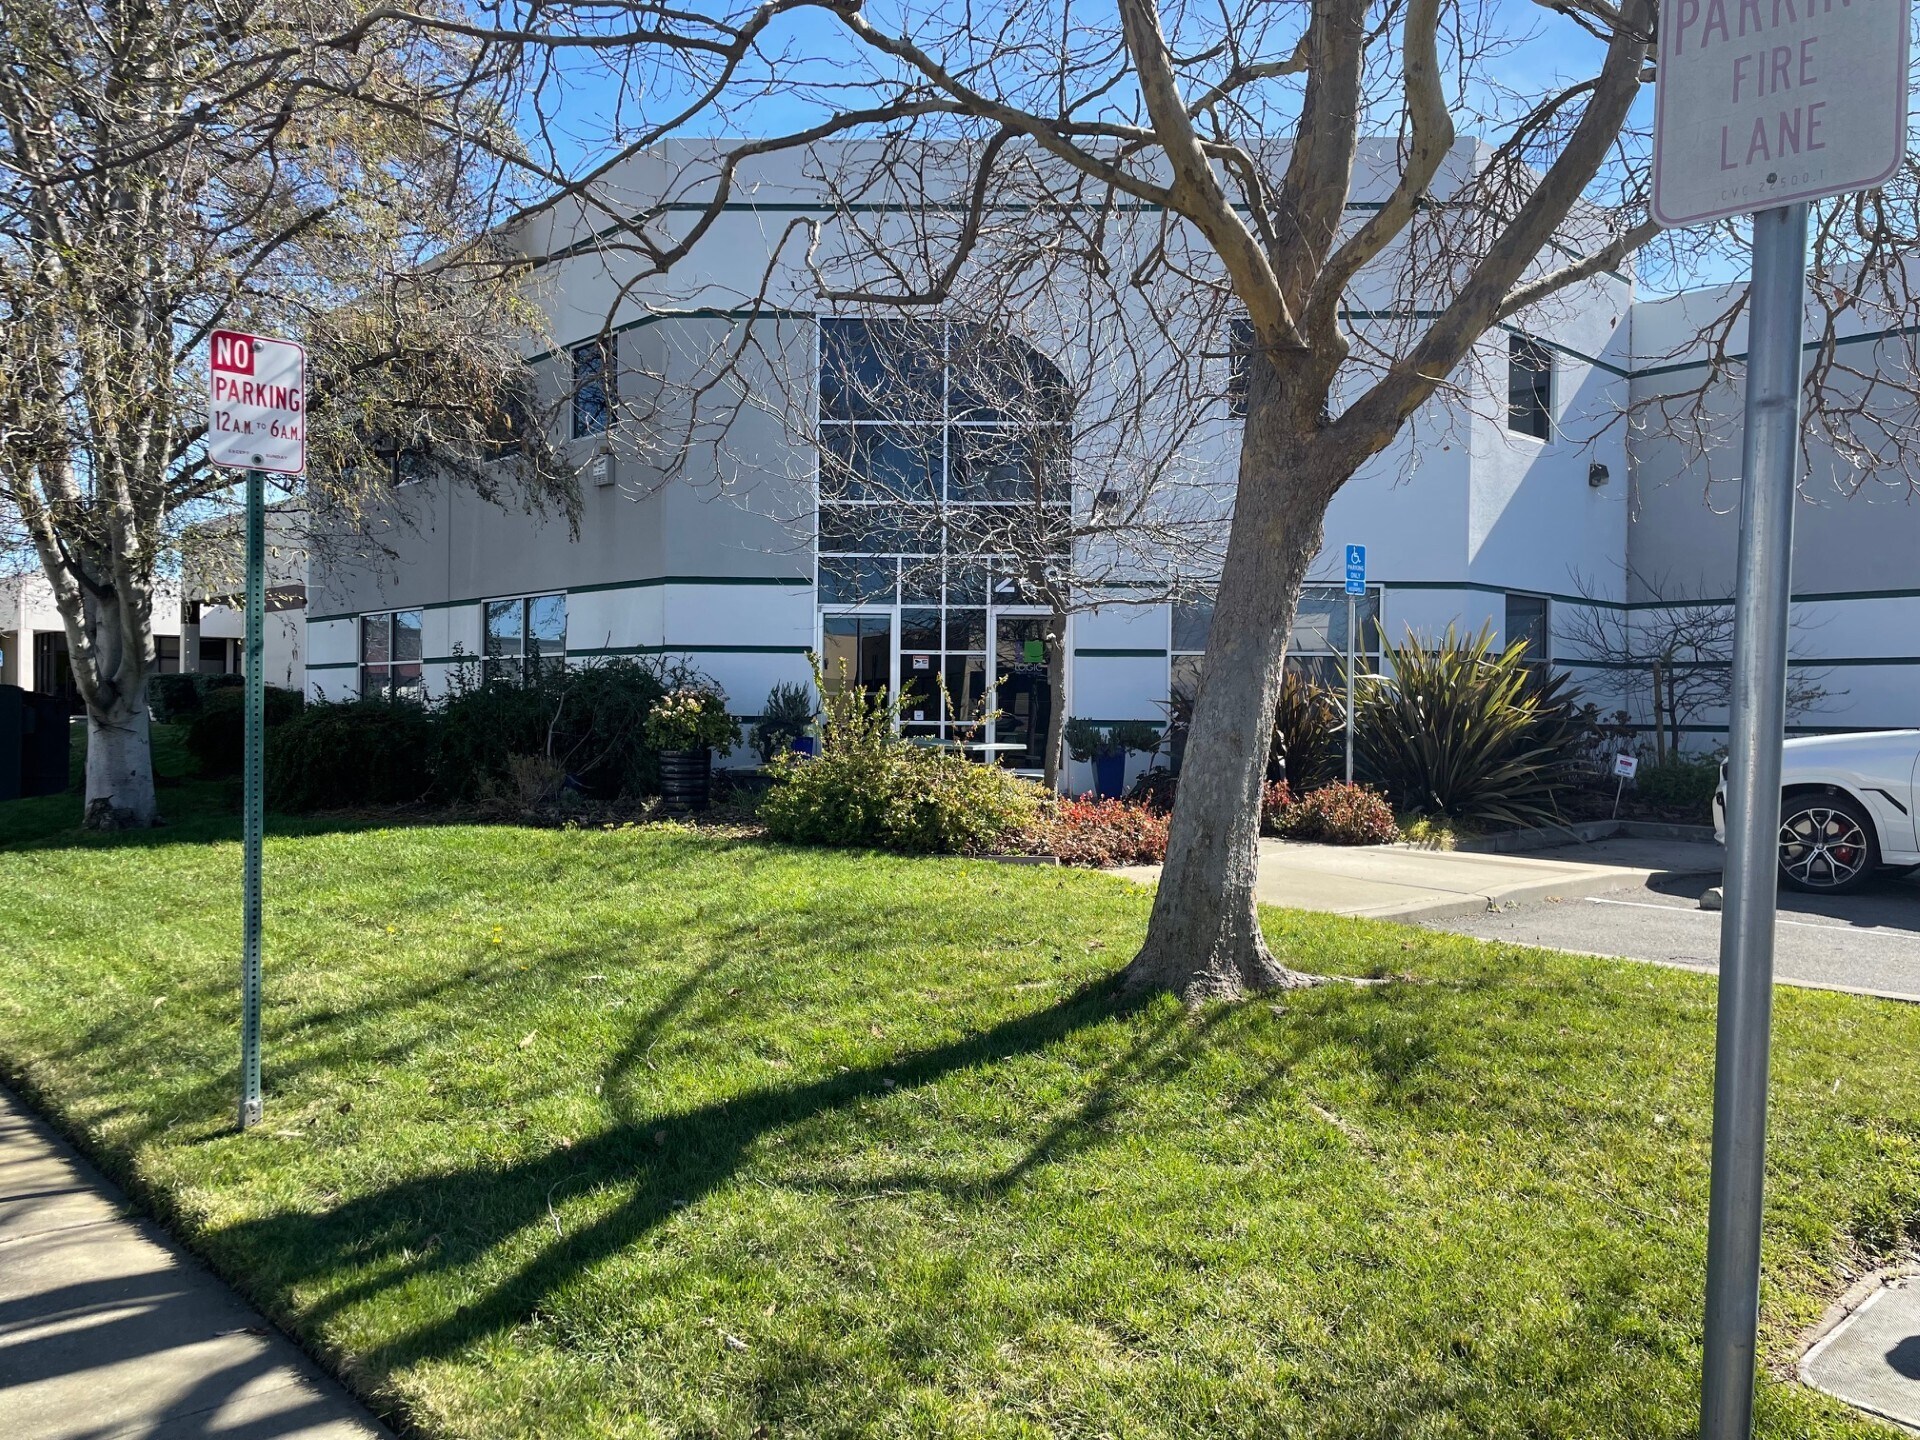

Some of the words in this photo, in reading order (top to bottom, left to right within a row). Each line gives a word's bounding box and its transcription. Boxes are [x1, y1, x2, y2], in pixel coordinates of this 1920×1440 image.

[1732, 37, 1818, 103] FIRE
[1720, 101, 1826, 171] LANE
[1721, 185, 1749, 201] CVC
[217, 336, 249, 369] NO
[216, 377, 300, 412] PARKING
[257, 422, 266, 430] TO
[1014, 663, 1043, 672] LOGIC
